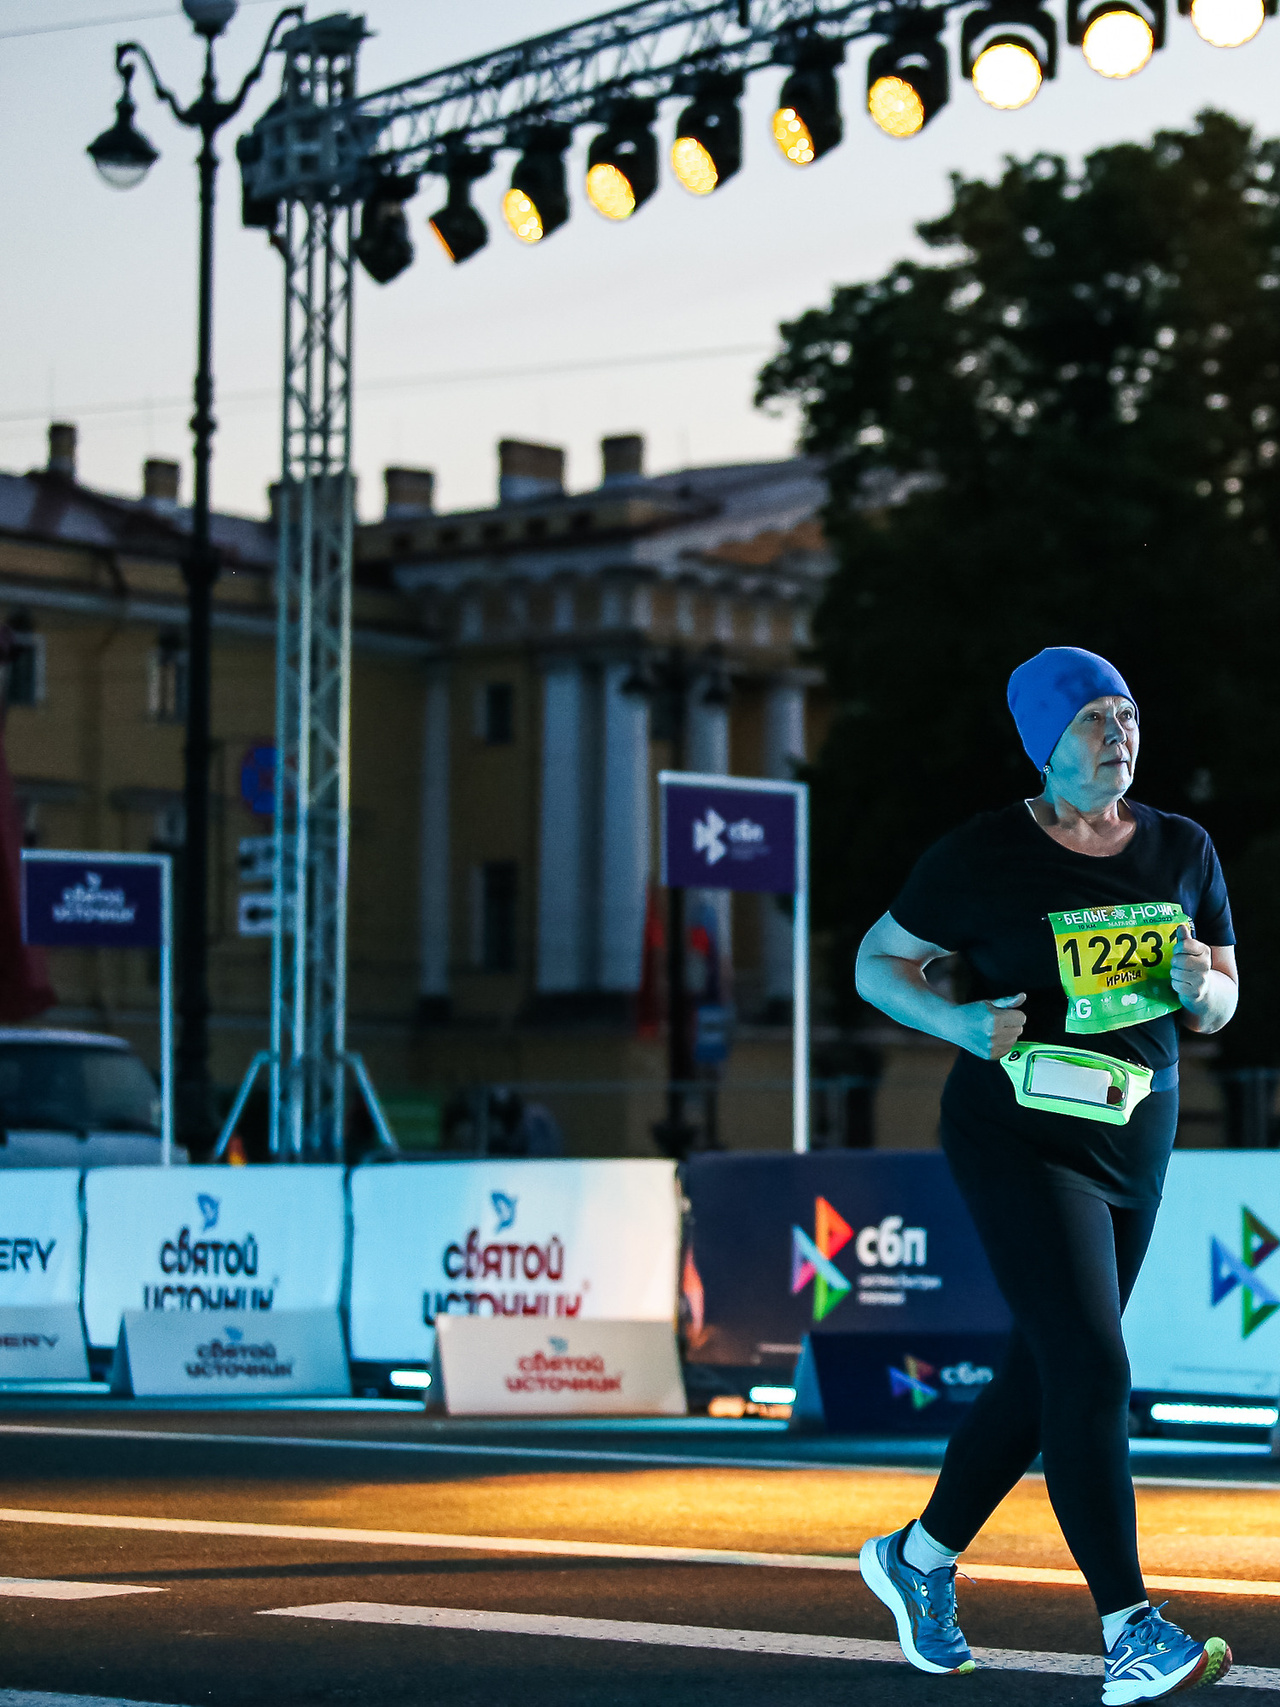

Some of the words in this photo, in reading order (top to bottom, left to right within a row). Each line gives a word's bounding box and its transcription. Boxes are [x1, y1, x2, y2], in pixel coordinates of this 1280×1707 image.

[1063, 909, 1109, 926] БЕЛЫЕ
[1130, 904, 1175, 920] НОЧИ
[1075, 998, 1092, 1019] G
[855, 1215, 927, 1268] сбп
[0, 1333, 58, 1349] ERY
